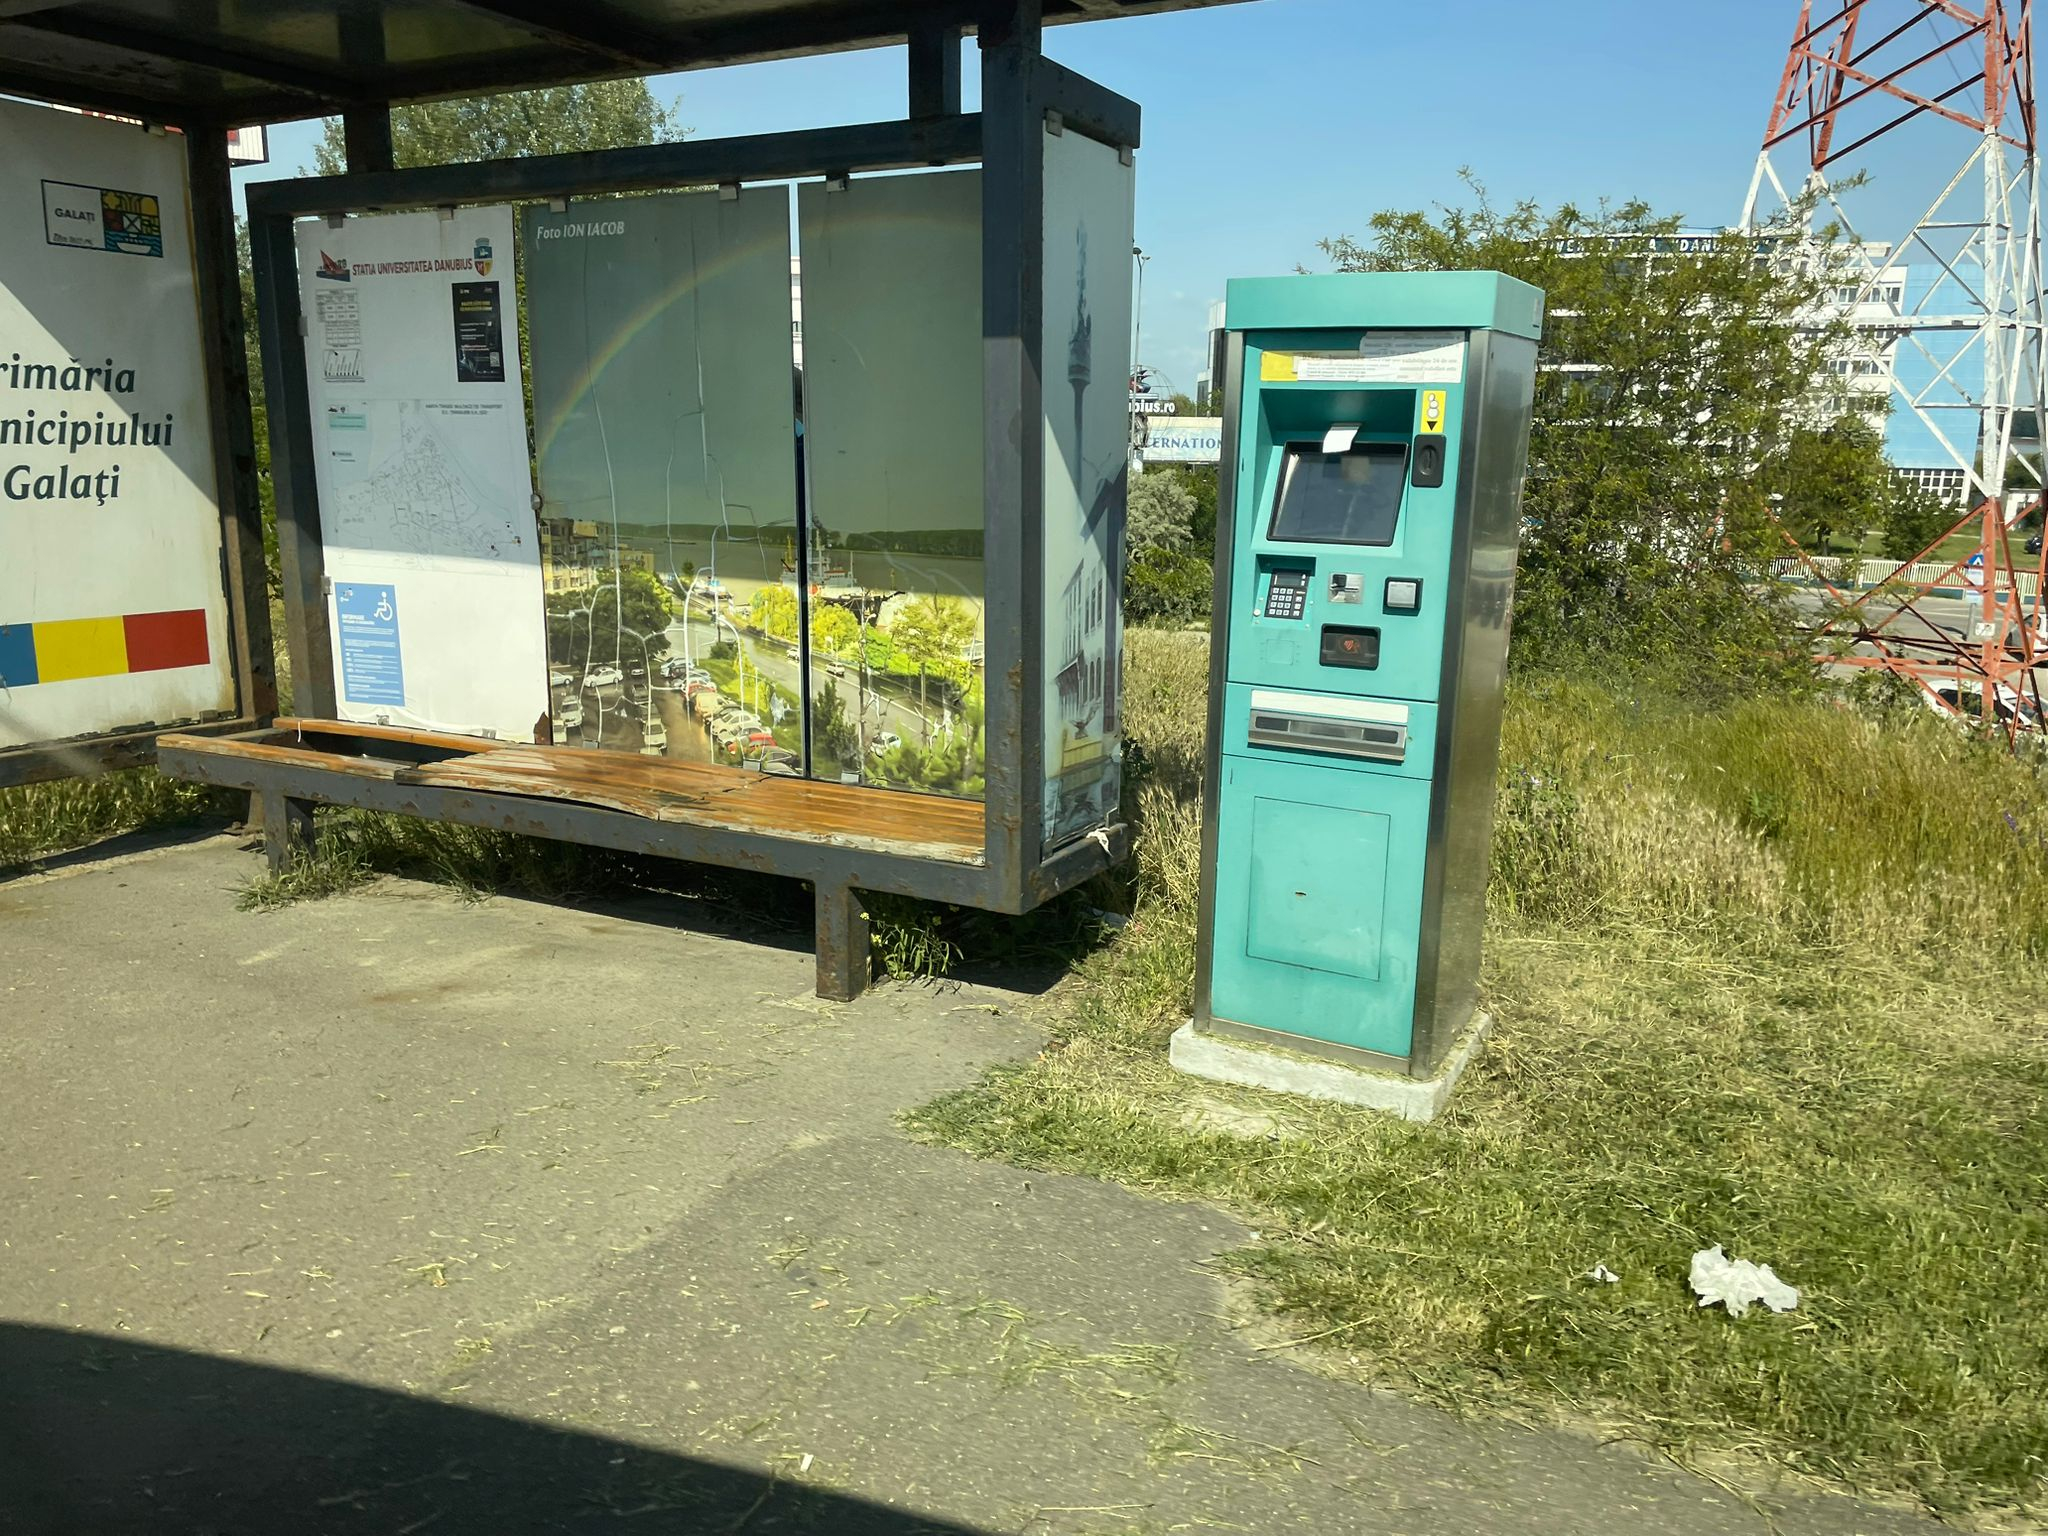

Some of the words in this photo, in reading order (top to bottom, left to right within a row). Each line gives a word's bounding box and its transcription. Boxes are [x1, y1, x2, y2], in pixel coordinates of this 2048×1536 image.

[537, 226, 561, 239] Foto
[563, 223, 585, 238] ION
[587, 221, 625, 237] IACOB
[352, 264, 376, 276] STATIA
[377, 261, 433, 275] UNIVERSITATEA
[434, 258, 473, 273] DANUBIUS
[0, 409, 174, 453] nicipiului
